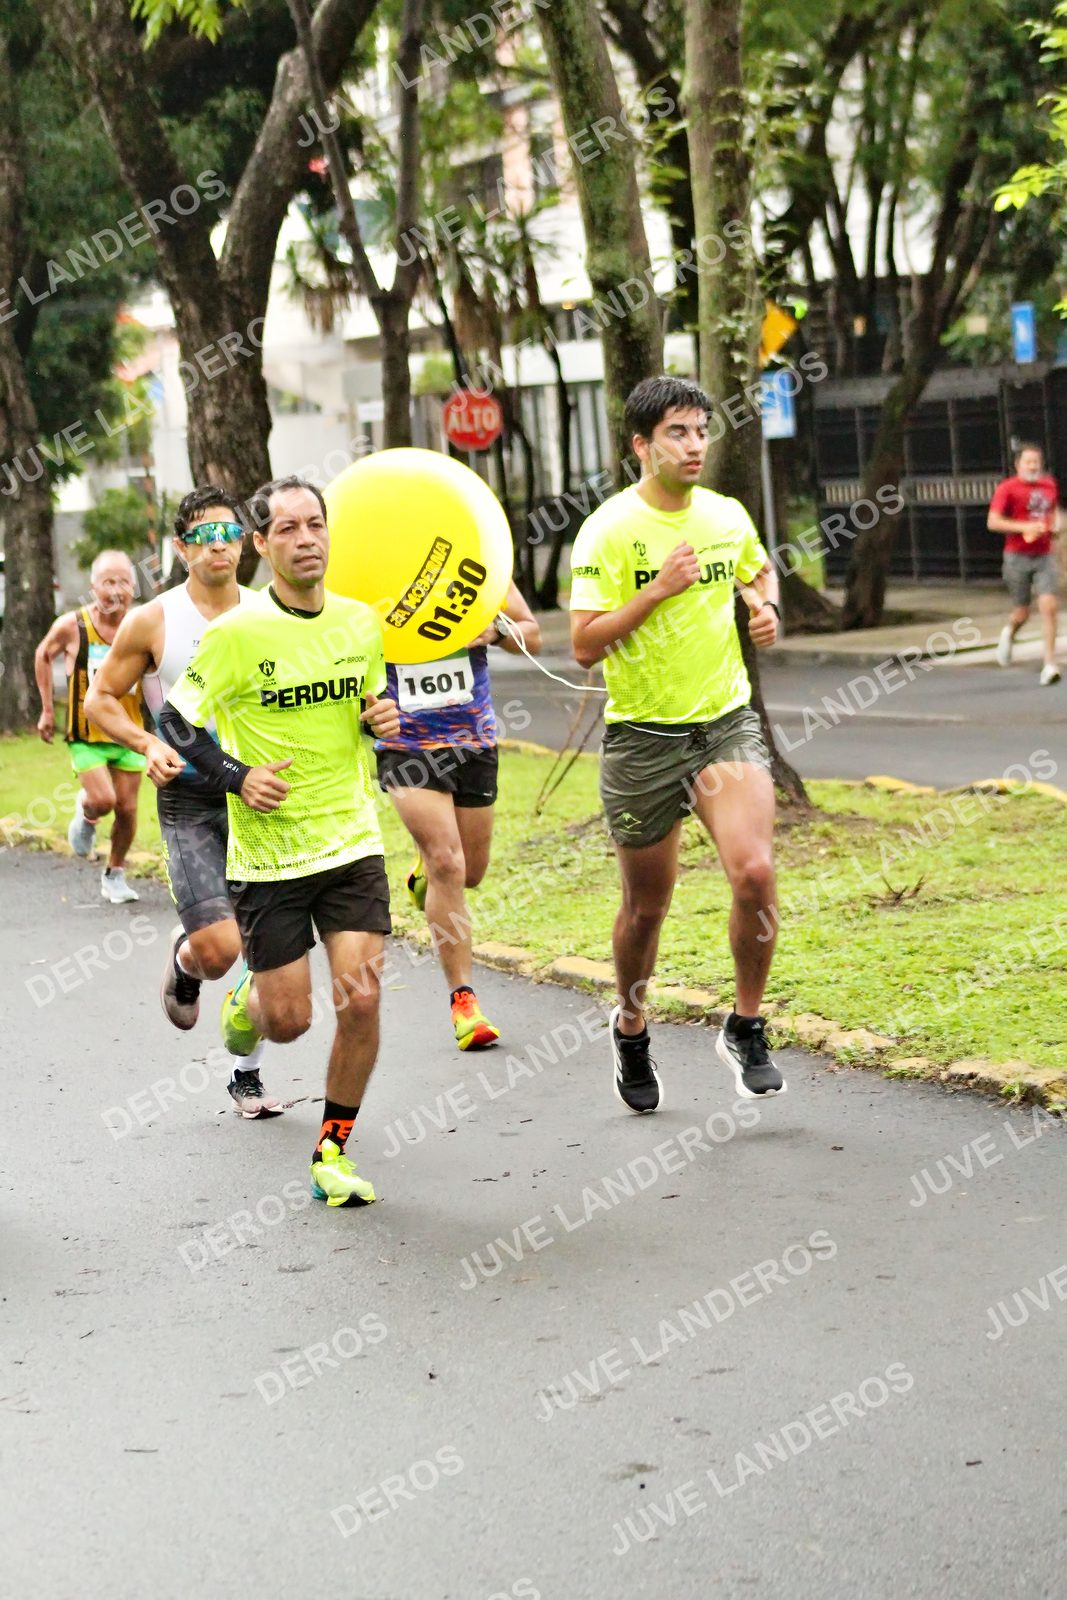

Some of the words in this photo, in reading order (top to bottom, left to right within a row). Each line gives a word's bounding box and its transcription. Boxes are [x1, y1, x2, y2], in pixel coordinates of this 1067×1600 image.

[447, 406, 499, 433] ALTO
[417, 558, 487, 641] 01:30
[404, 670, 467, 696] 1601
